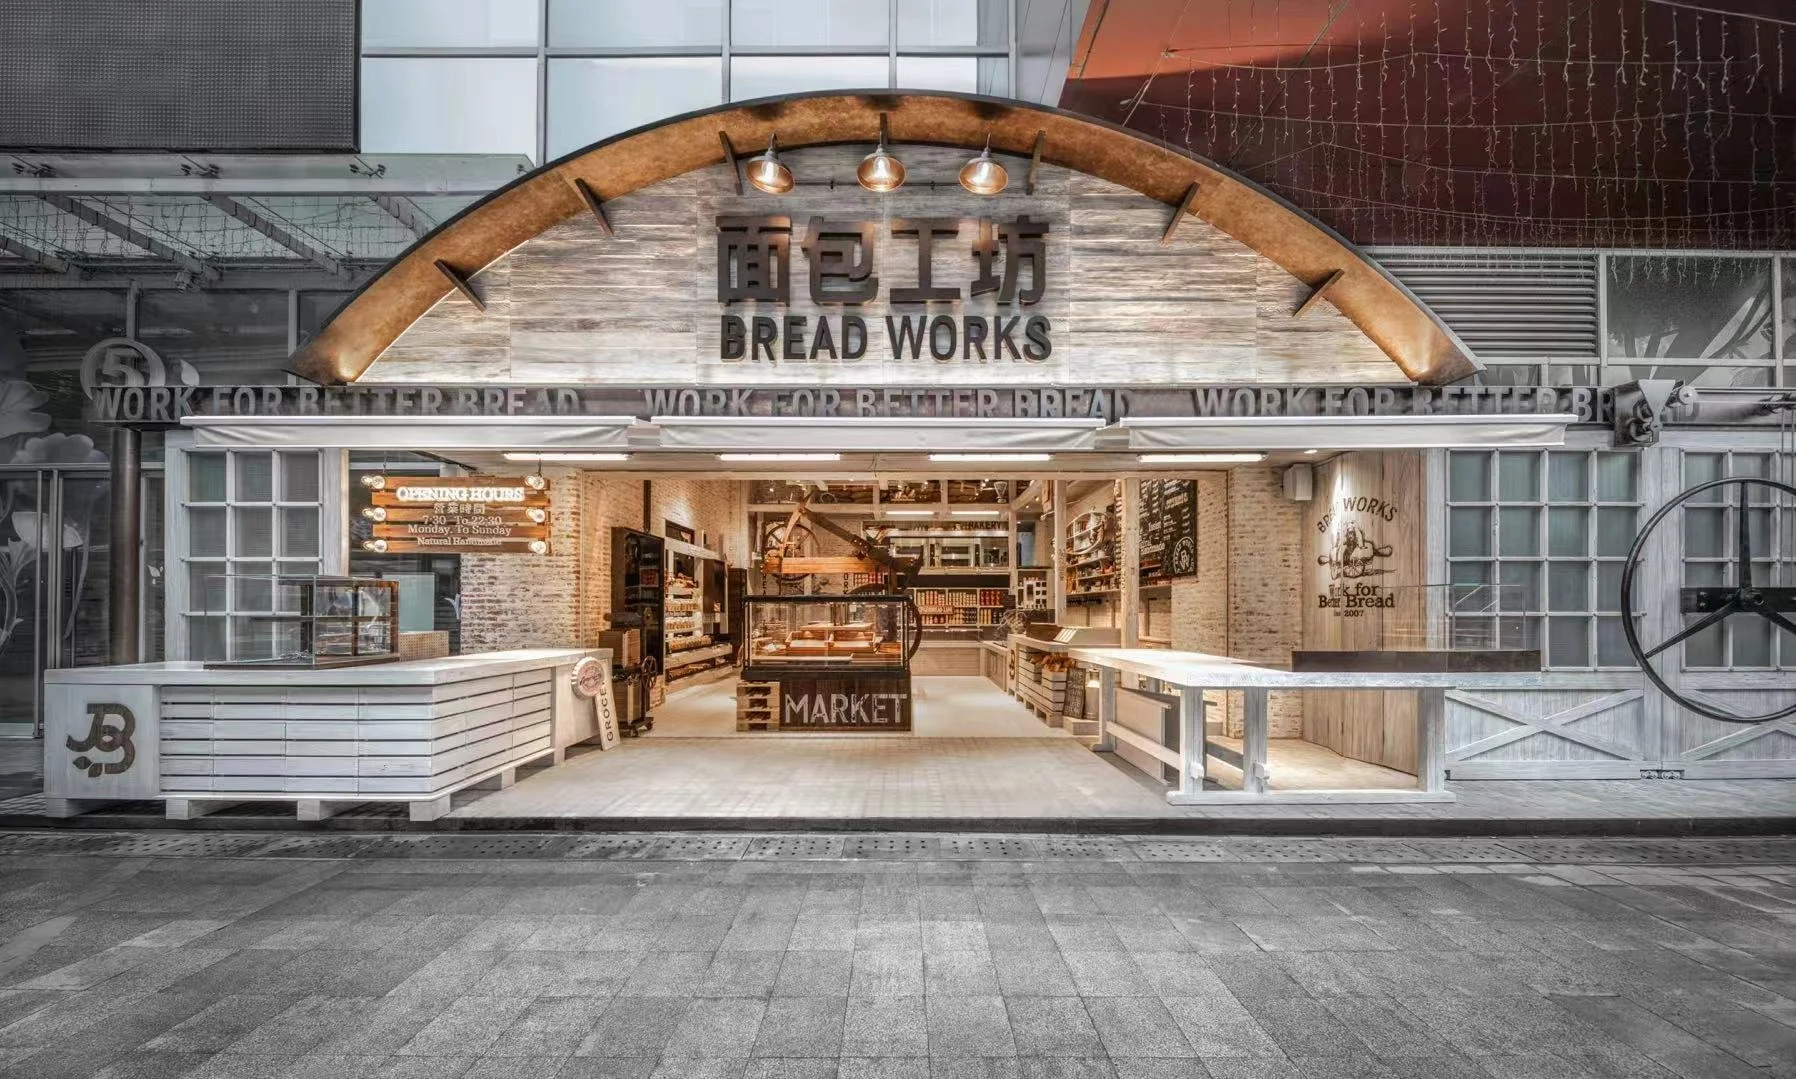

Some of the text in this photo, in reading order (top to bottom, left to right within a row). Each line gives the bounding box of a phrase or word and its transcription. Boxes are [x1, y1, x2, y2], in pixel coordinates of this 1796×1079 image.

[715, 214, 1050, 306] 面包工坊
[720, 315, 1052, 362] BREAD WORKS
[95, 386, 196, 421] WORK
[212, 387, 283, 416] FOR
[300, 387, 443, 416] BETTER
[458, 386, 580, 416] BREAD
[644, 388, 752, 417] WORK
[771, 388, 841, 417] FOR
[856, 388, 998, 417] BETTER
[1013, 388, 1129, 418] BREAD
[1195, 386, 1308, 416] WORK
[1324, 386, 1395, 416] FOR
[396, 486, 525, 502] OPENING HOURS
[1343, 496, 1398, 522] WORKS
[422, 515, 502, 525] 7:30 To 22:30
[455, 524, 470, 535] To
[472, 524, 512, 536] Sunday
[417, 536, 451, 546] Natural
[1354, 582, 1380, 597] for
[1345, 593, 1396, 609] Bread
[1343, 609, 1364, 618] 2007
[784, 693, 908, 724] MARKET
